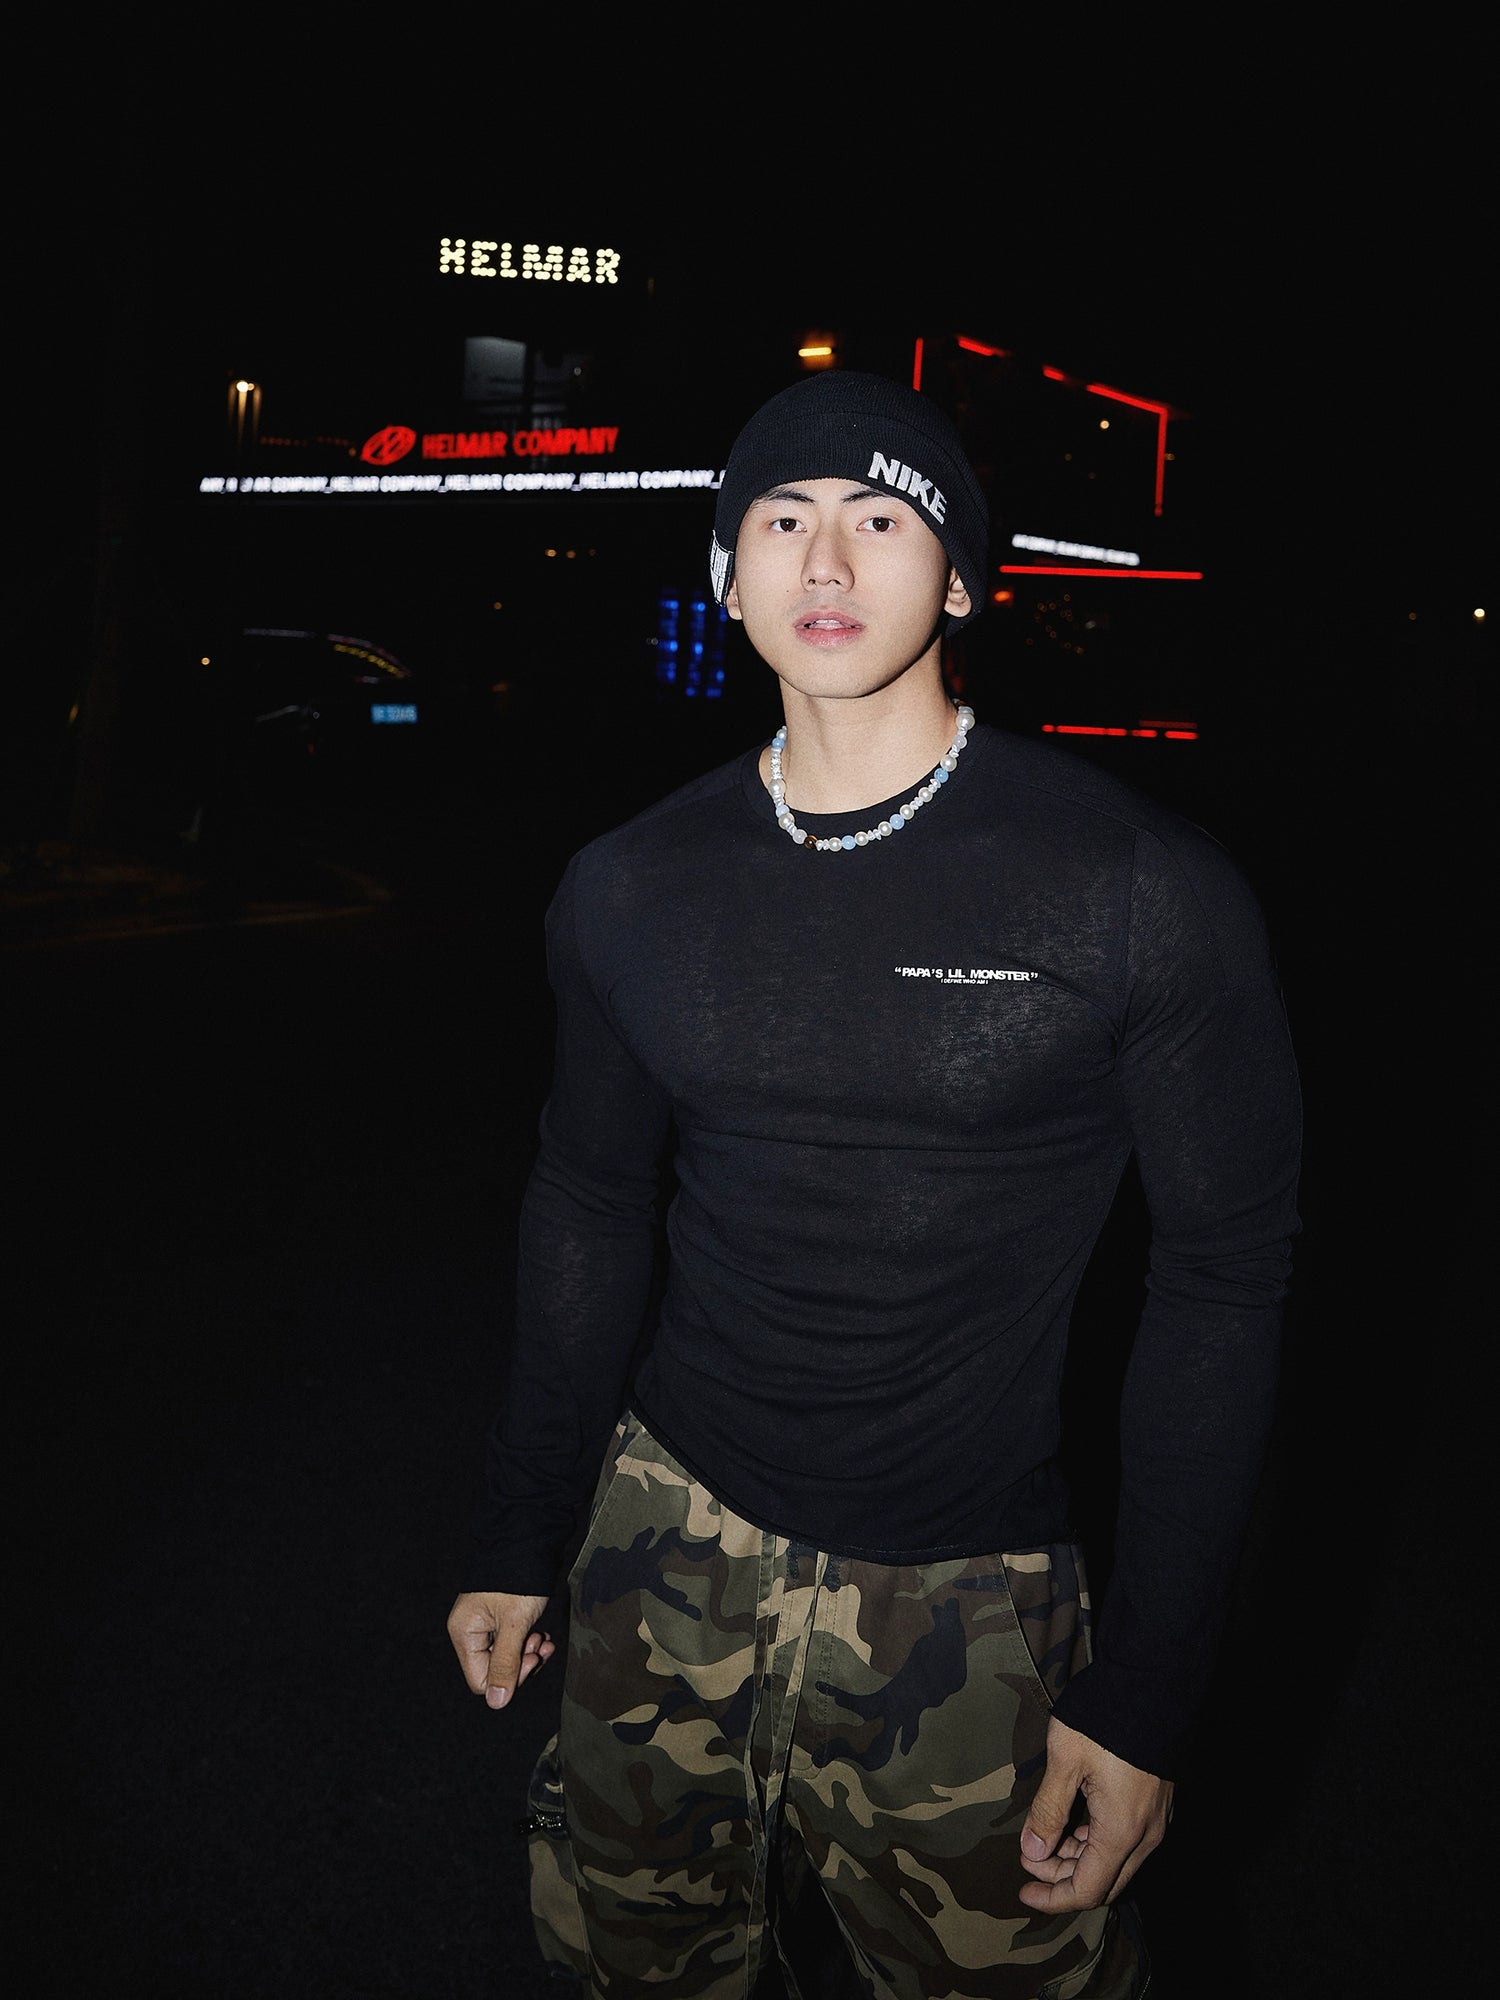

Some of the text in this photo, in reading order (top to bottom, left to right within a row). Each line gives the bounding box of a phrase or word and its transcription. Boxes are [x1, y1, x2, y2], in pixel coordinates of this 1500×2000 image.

[439, 237, 621, 284] HELMAR
[422, 427, 619, 459] HELMAR COMPANY
[867, 451, 948, 525] NIKE
[948, 968, 965, 978] LIL
